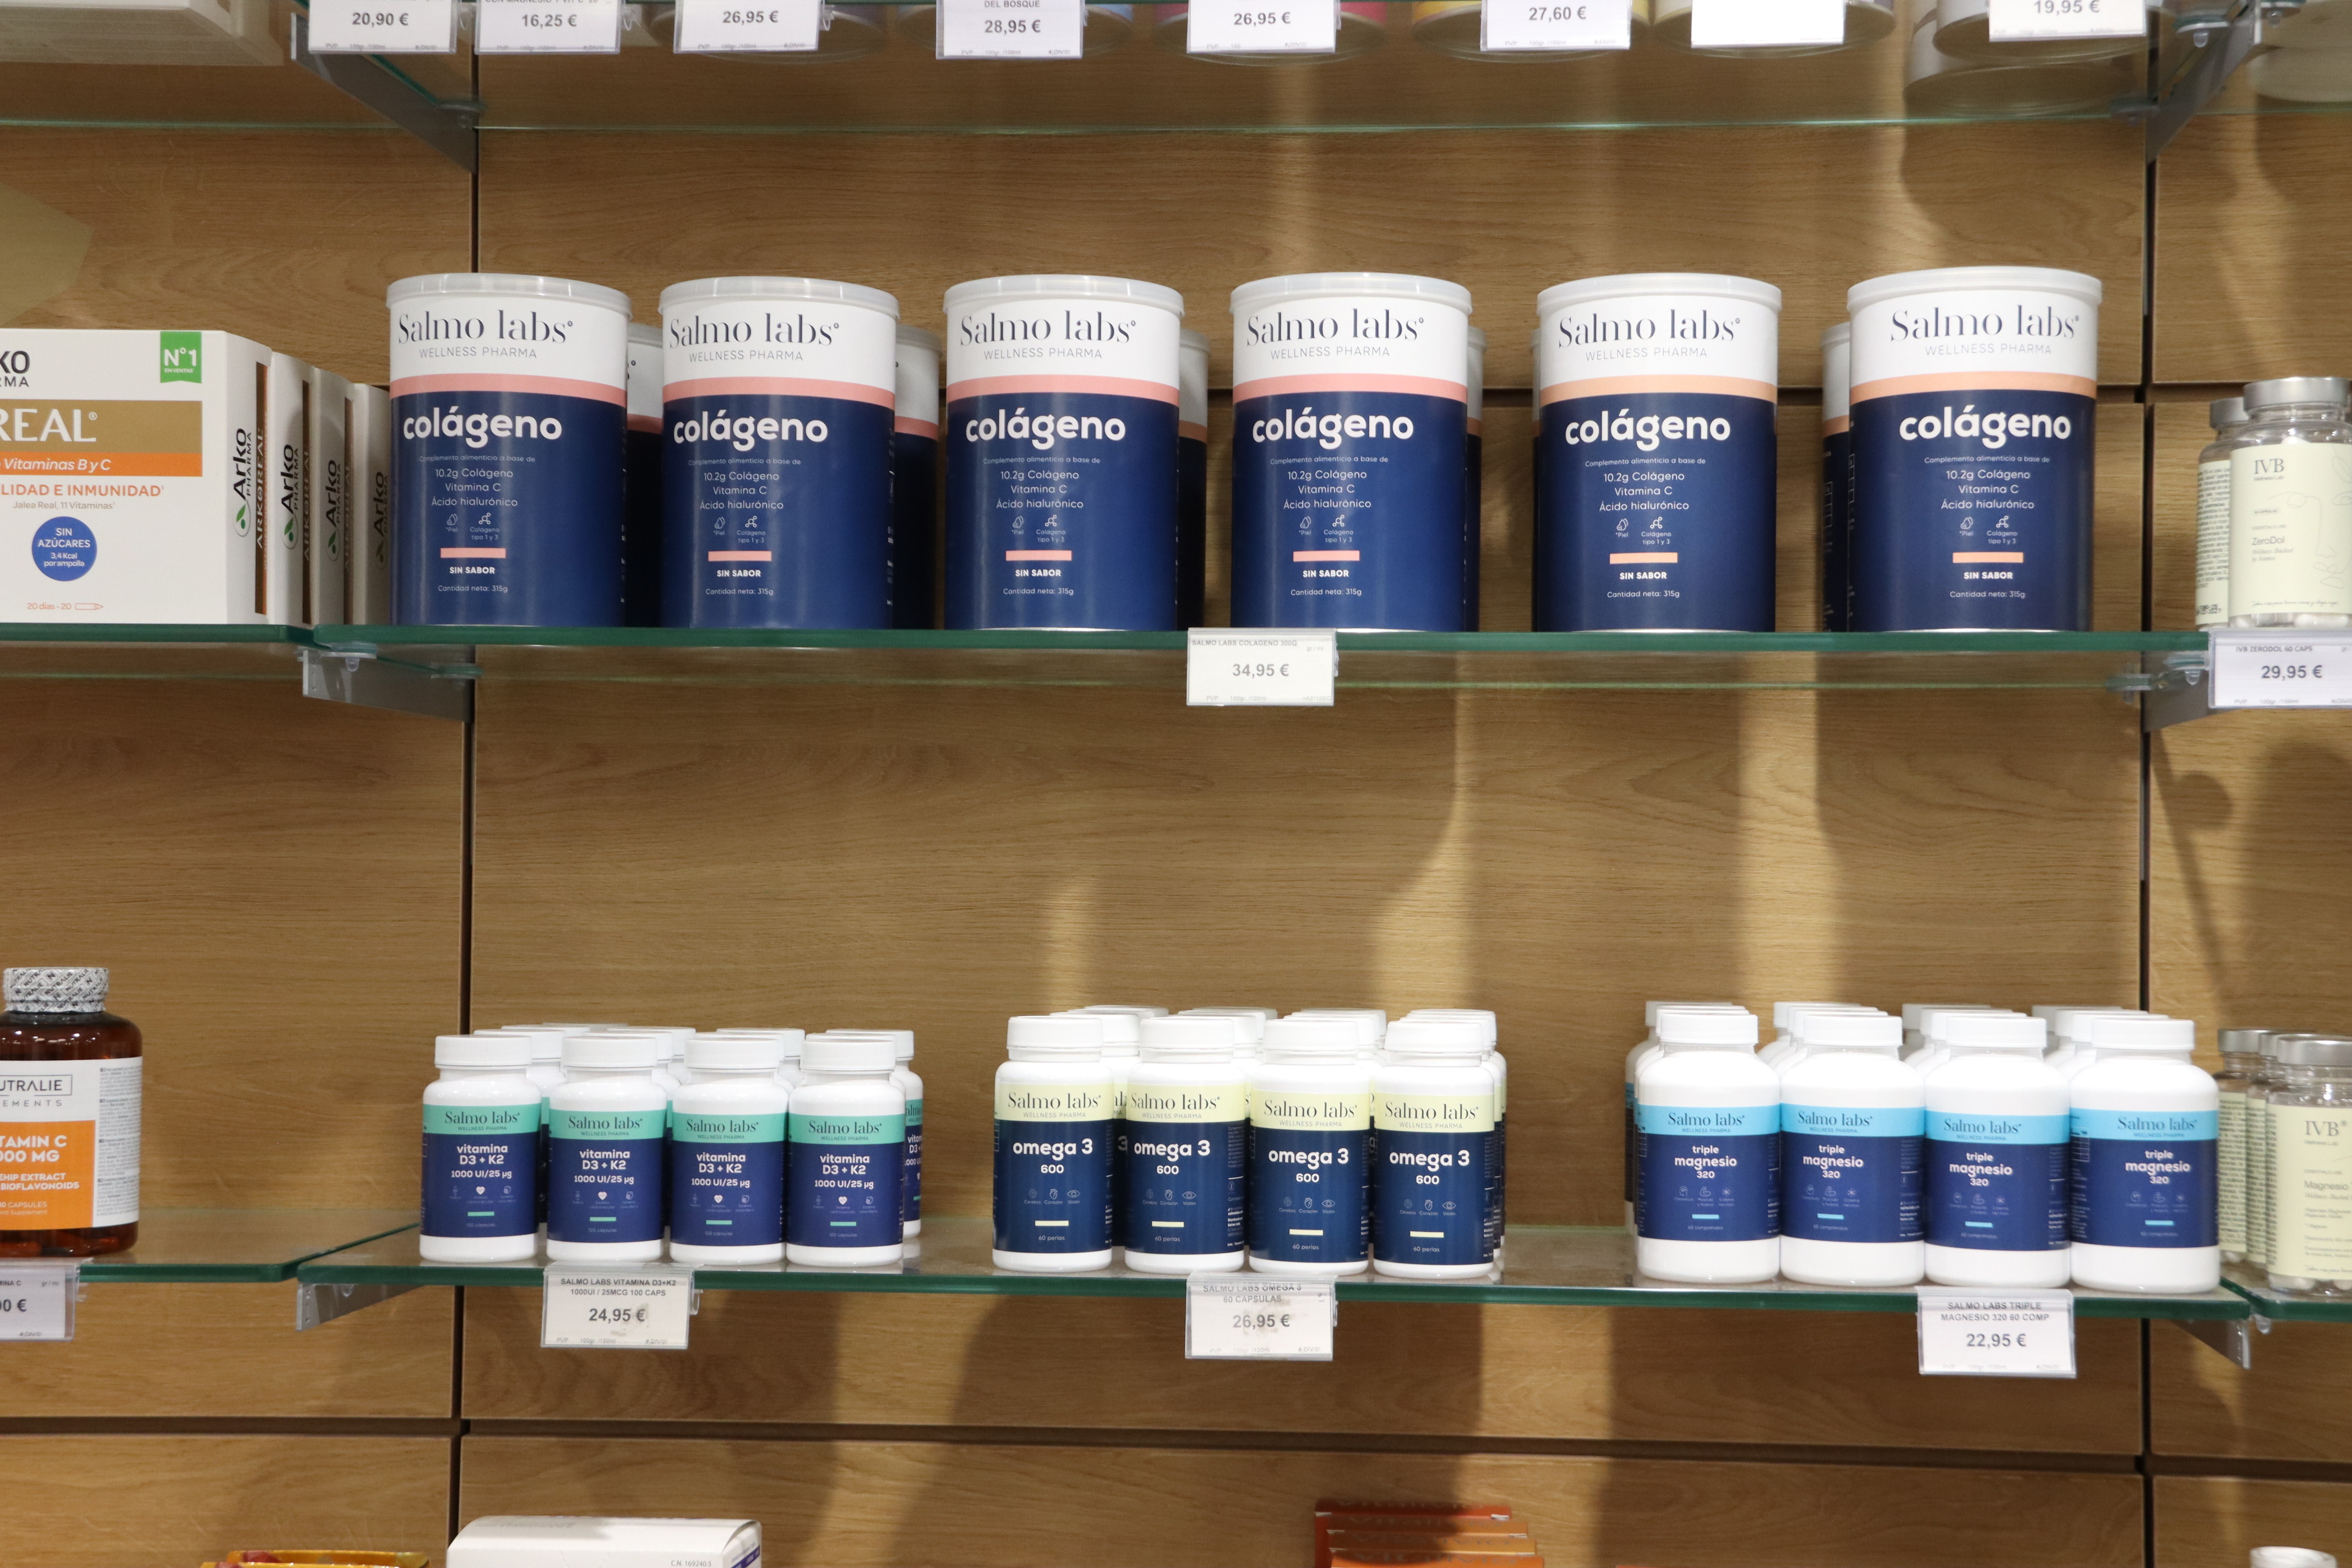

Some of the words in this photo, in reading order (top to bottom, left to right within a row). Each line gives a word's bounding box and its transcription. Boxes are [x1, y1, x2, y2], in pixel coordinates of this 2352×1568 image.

[1529, 7, 1571, 22] 27,60
[1577, 7, 1586, 19] €
[2035, 0, 2082, 15] 19,95
[2089, 0, 2099, 13] €
[352, 13, 394, 27] 20,90
[399, 13, 408, 25] €
[522, 14, 562, 29] 16,25
[568, 14, 576, 26] €
[723, 12, 764, 25] 26,95
[770, 11, 778, 23] €
[1234, 13, 1276, 26] 26,95
[1282, 12, 1290, 24] €
[985, 20, 1026, 35] 28,95
[1032, 20, 1040, 32] €
[399, 311, 484, 343] Salmo
[670, 315, 751, 347] Salmo
[961, 313, 1050, 346] Salmo
[1247, 312, 1338, 346] Salmo
[1559, 313, 1655, 348] Salmo
[1891, 307, 2002, 341] Salmo
[1586, 348, 1647, 361] WELLNESS
[1654, 347, 1707, 357] PHARMA
[404, 406, 562, 448] colágeno
[674, 410, 827, 451] colágeno
[967, 407, 1125, 450] colágeno
[1253, 407, 1413, 449] colágeno
[1566, 409, 1730, 451] colágeno
[1900, 405, 2070, 449] colágeno
[5, 458, 75, 470] Vitaminas
[78, 459, 87, 470] B
[89, 462, 98, 473] y
[101, 459, 111, 470] C
[232, 428, 247, 501] Arko
[2254, 459, 2284, 474] IVB
[280, 444, 294, 515] Arko
[1604, 473, 1628, 483] 10.2g
[1632, 472, 1684, 482] Colágeno
[54, 484, 63, 496] E
[1615, 487, 1660, 496] Vitamina
[1664, 486, 1672, 494] C
[1599, 502, 1627, 511] Ácido
[1631, 501, 1689, 509] hialurónico
[38, 537, 90, 547] AZÚCARES
[2252, 536, 2284, 545] ZeroDol
[1233, 664, 1274, 678] 34,95
[1280, 664, 1288, 676] €
[2262, 666, 2306, 679] 29,95
[2313, 665, 2322, 678] €
[54, 1135, 67, 1147] C
[457, 1144, 508, 1153] vitamina
[1013, 1143, 1076, 1161] omega
[1082, 1139, 1092, 1154] 3
[1692, 1145, 1719, 1156] triple
[31, 1150, 60, 1162] MG
[460, 1155, 476, 1164] D3
[489, 1155, 504, 1164] K2
[1675, 1156, 1736, 1170] magnesio
[1041, 1164, 1064, 1173] 600
[21, 1173, 66, 1181] EXTRACT
[1, 1182, 79, 1190] BIOFLAVONOIDS
[2304, 1180, 2348, 1190] Magnesio
[589, 1309, 630, 1323] 24,95
[636, 1309, 645, 1321] €
[1234, 1315, 1275, 1330] 26,95
[1281, 1314, 1289, 1327] €
[1967, 1334, 2011, 1348] 22,95
[2017, 1333, 2026, 1347] €
